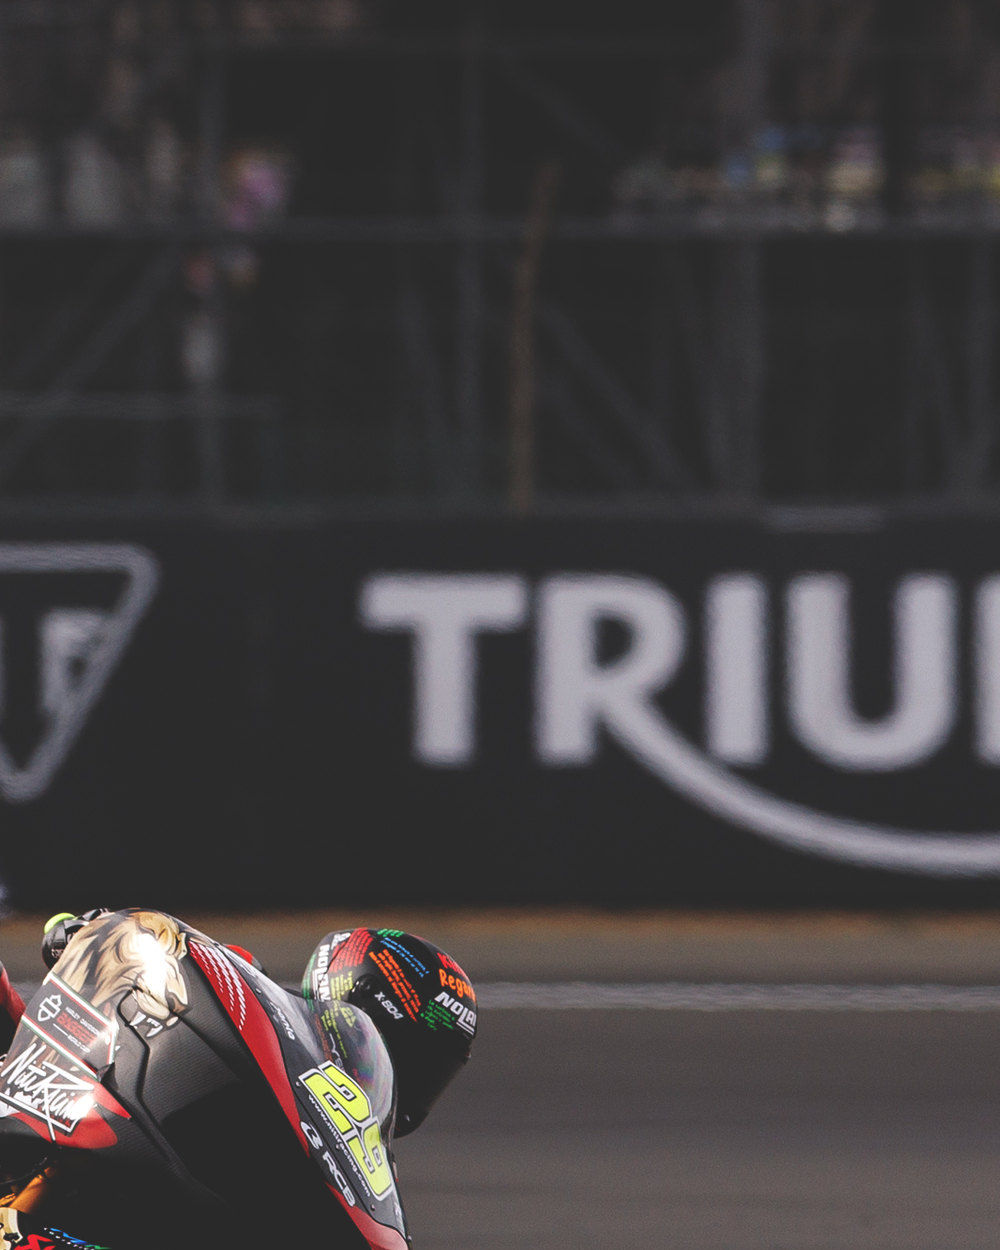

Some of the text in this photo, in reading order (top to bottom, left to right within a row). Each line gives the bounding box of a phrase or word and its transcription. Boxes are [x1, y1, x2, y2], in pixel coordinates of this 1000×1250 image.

[359, 572, 1000, 774] TRIU
[298, 1060, 395, 1201] 29
[323, 1151, 356, 1208] RCB
